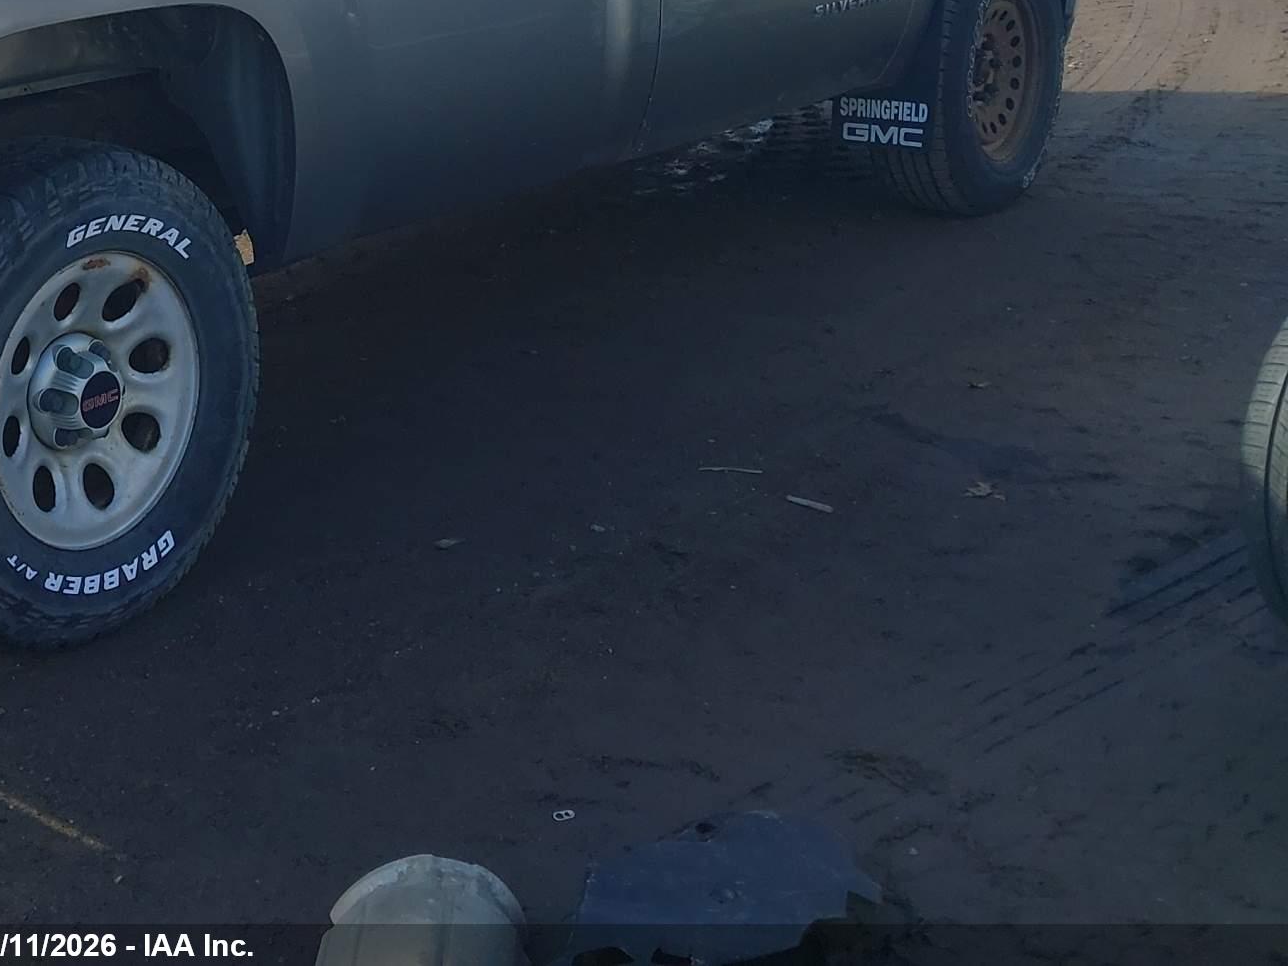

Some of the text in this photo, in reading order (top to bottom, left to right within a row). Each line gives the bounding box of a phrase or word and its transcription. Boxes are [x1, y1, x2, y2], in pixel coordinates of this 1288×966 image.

[839, 96, 929, 123] SPRINGFIELD
[842, 122, 924, 148] GMC
[66, 214, 192, 259] GENERAL
[82, 388, 119, 412] GMC
[6, 529, 176, 595] GRABBER A/T
